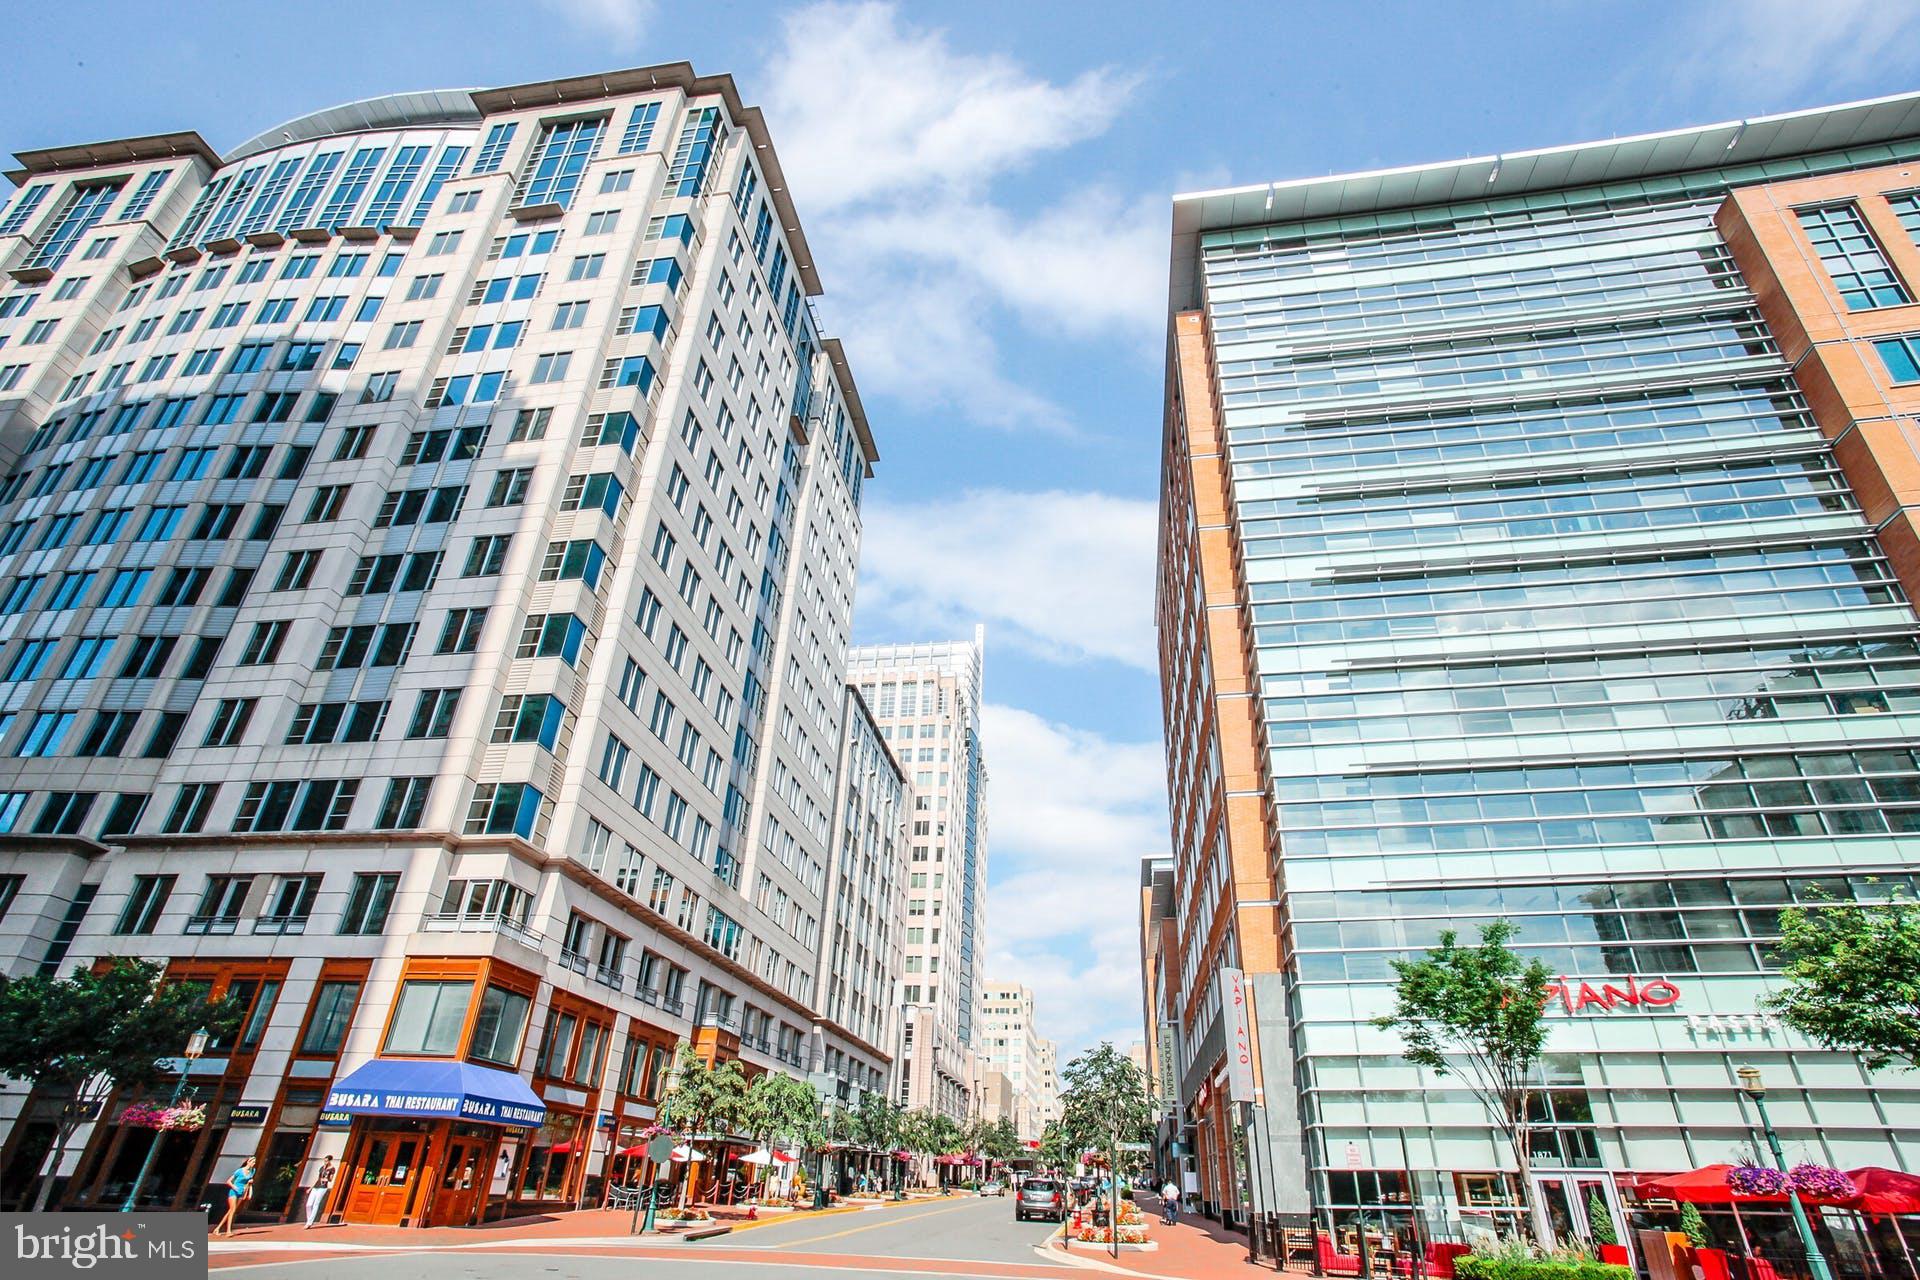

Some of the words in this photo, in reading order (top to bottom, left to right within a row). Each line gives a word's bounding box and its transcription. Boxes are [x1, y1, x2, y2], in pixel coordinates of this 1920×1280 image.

[328, 1093, 379, 1108] BUSARA
[384, 1095, 404, 1109] THAI
[404, 1096, 459, 1112] RESTAURANT
[231, 1110, 260, 1118] BUSARA
[462, 1099, 496, 1117] BUSARA
[500, 1105, 514, 1118] THAI
[513, 1107, 544, 1123] RESTAURANT
[319, 1113, 350, 1121] BUSARA
[1532, 1150, 1553, 1159] 1871
